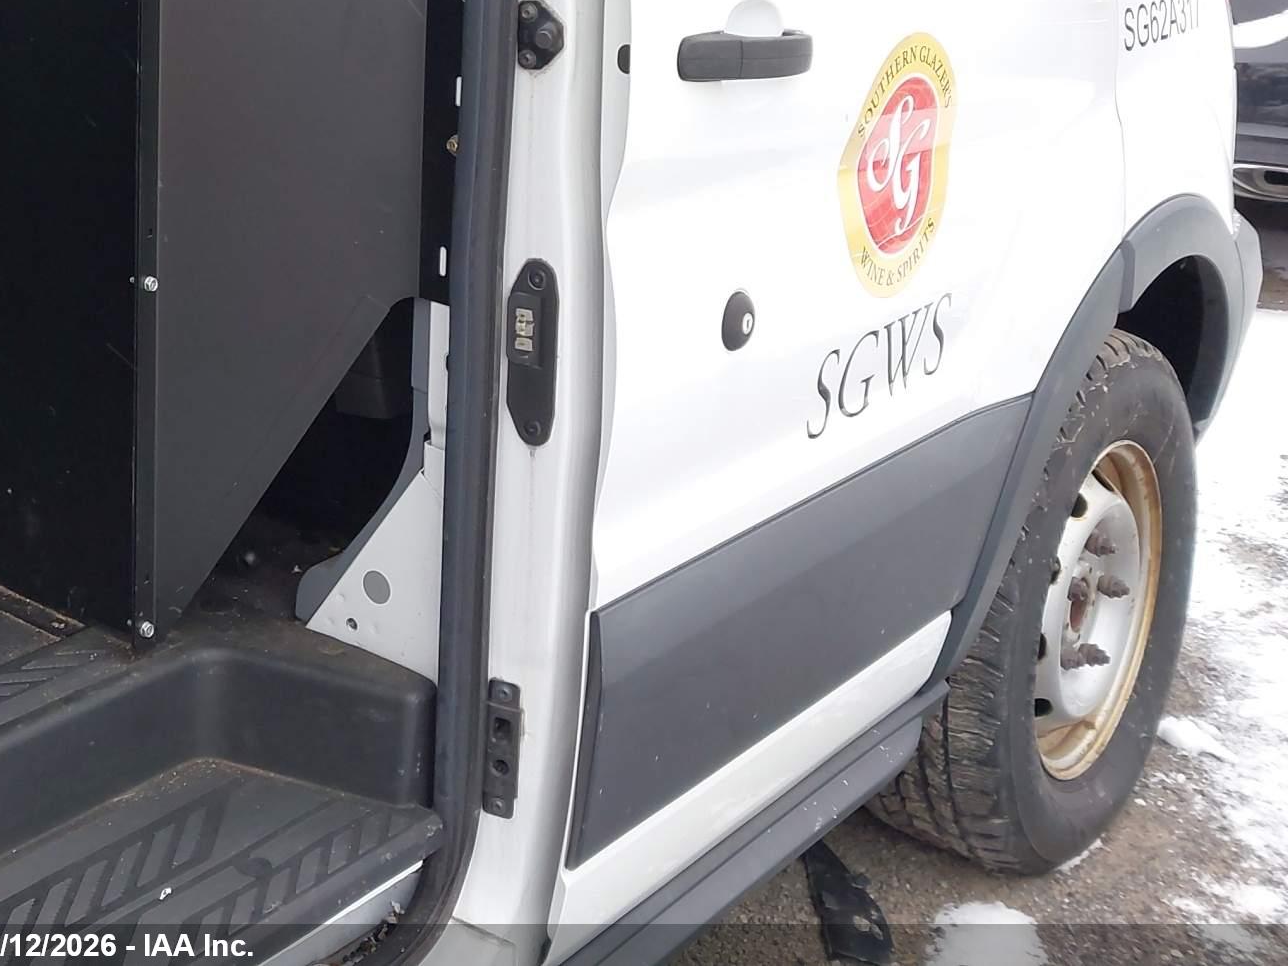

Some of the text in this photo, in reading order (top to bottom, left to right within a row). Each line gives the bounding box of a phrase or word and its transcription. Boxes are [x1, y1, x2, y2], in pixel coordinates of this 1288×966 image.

[857, 45, 952, 138] SOUTHERN GLAZER'S
[860, 217, 935, 286] WINE & SPIRITS
[807, 292, 952, 439] SGWS
